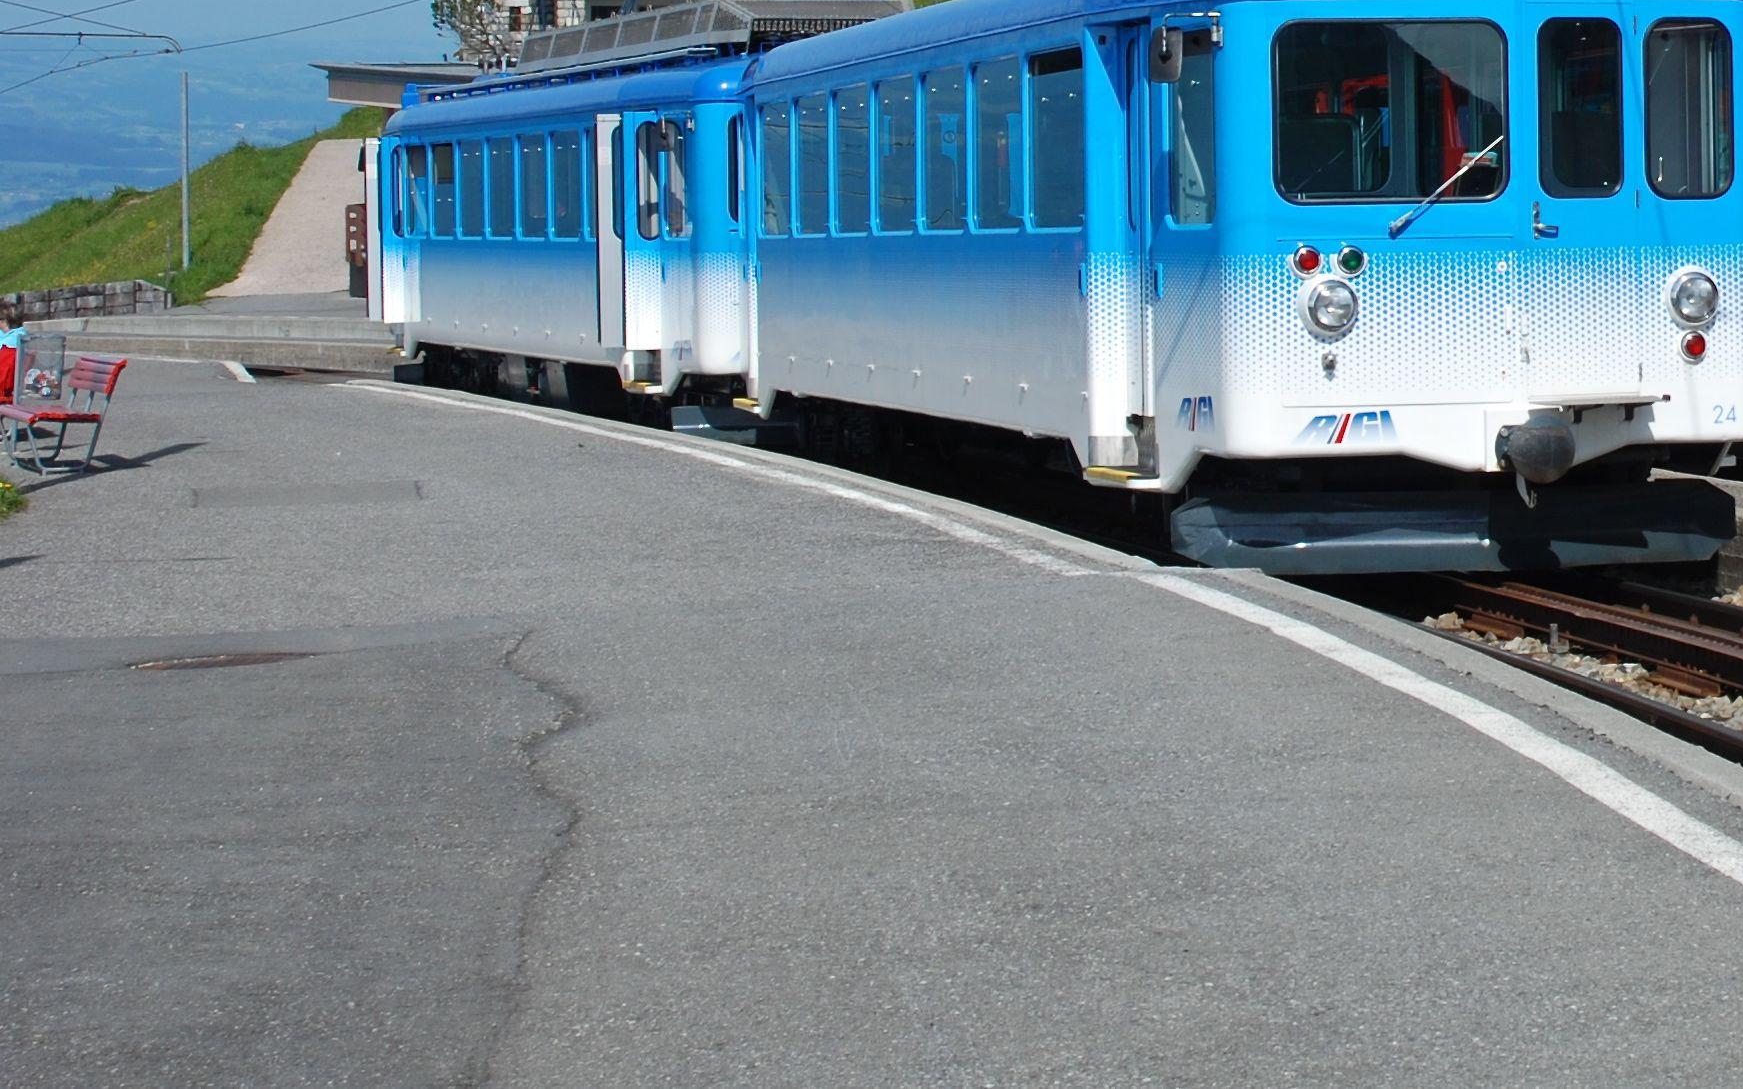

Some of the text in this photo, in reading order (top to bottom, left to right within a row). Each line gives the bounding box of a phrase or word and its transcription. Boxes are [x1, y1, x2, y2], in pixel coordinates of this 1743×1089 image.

[1175, 396, 1216, 431] RIGI
[1292, 410, 1399, 444] RIGI
[1713, 405, 1736, 423] 24
